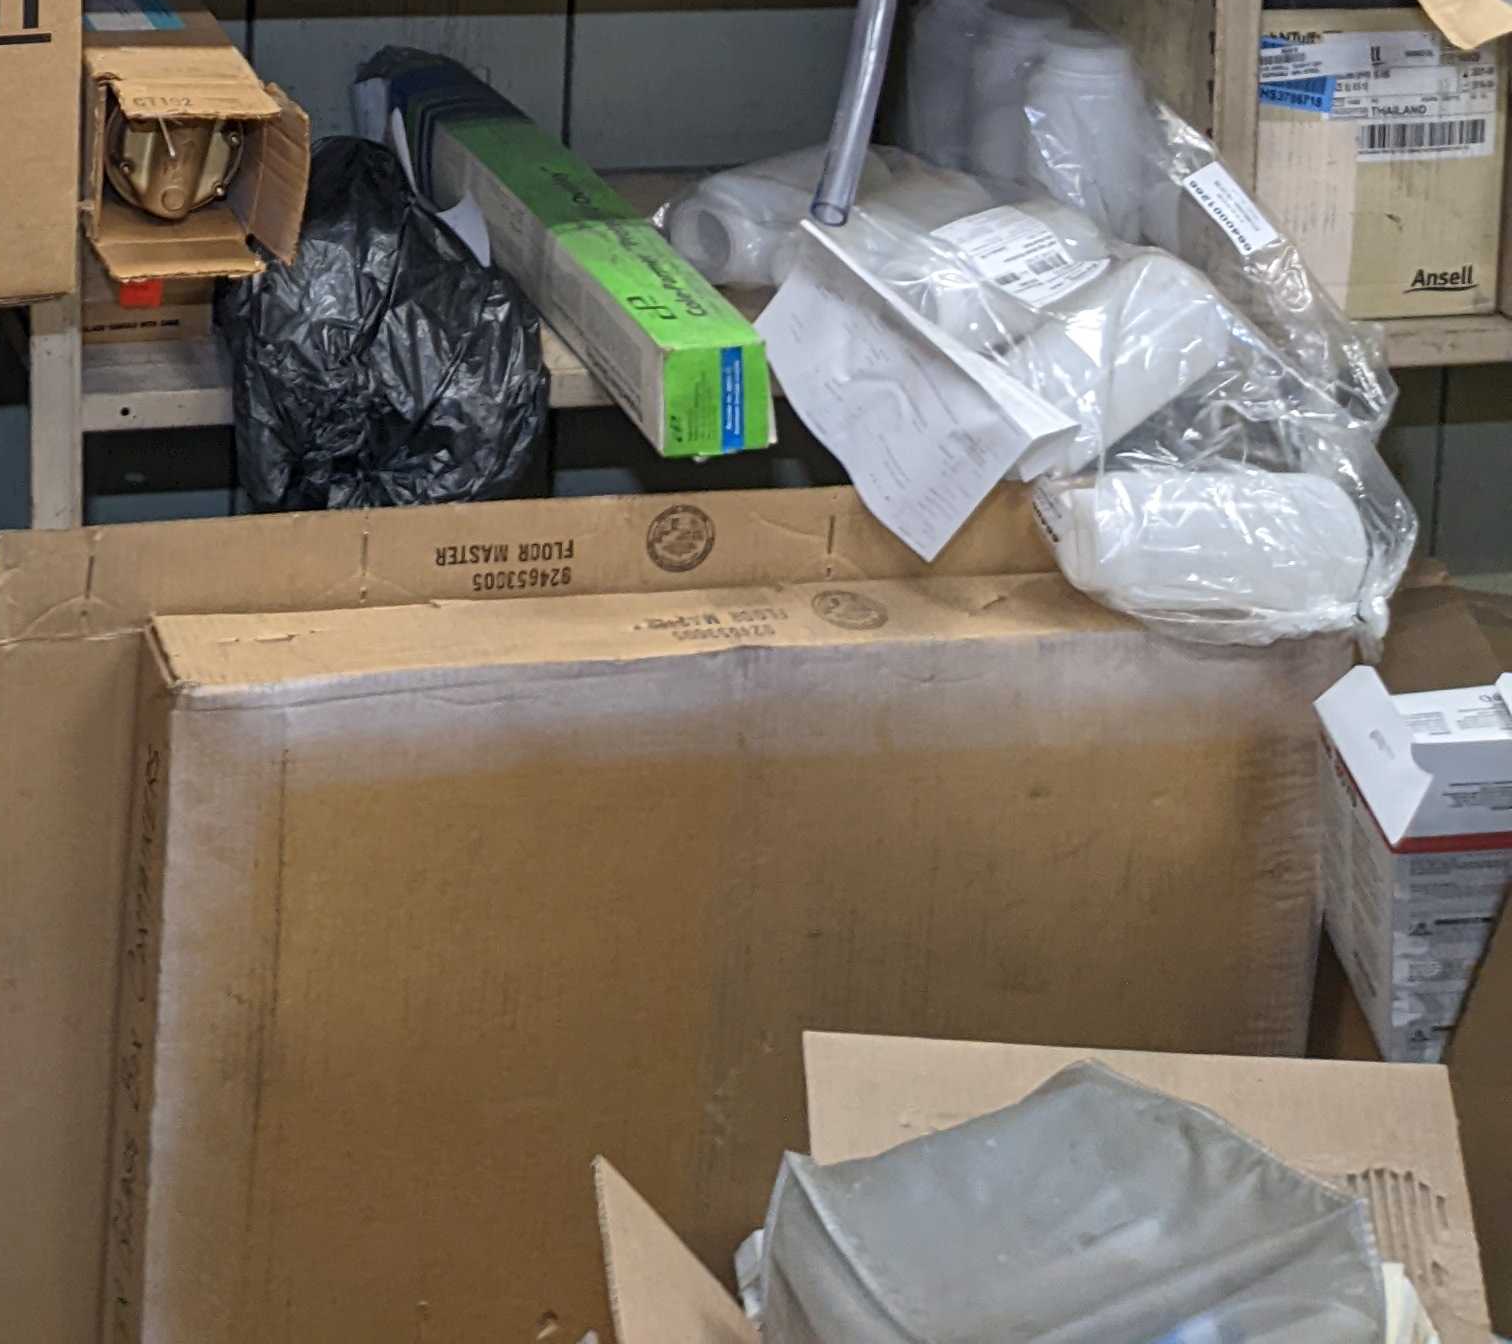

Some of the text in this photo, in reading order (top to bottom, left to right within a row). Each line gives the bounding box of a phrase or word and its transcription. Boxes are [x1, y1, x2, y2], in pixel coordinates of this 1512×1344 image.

[1411, 266, 1475, 286] Ansell
[435, 539, 575, 567] FLOOR MASTER
